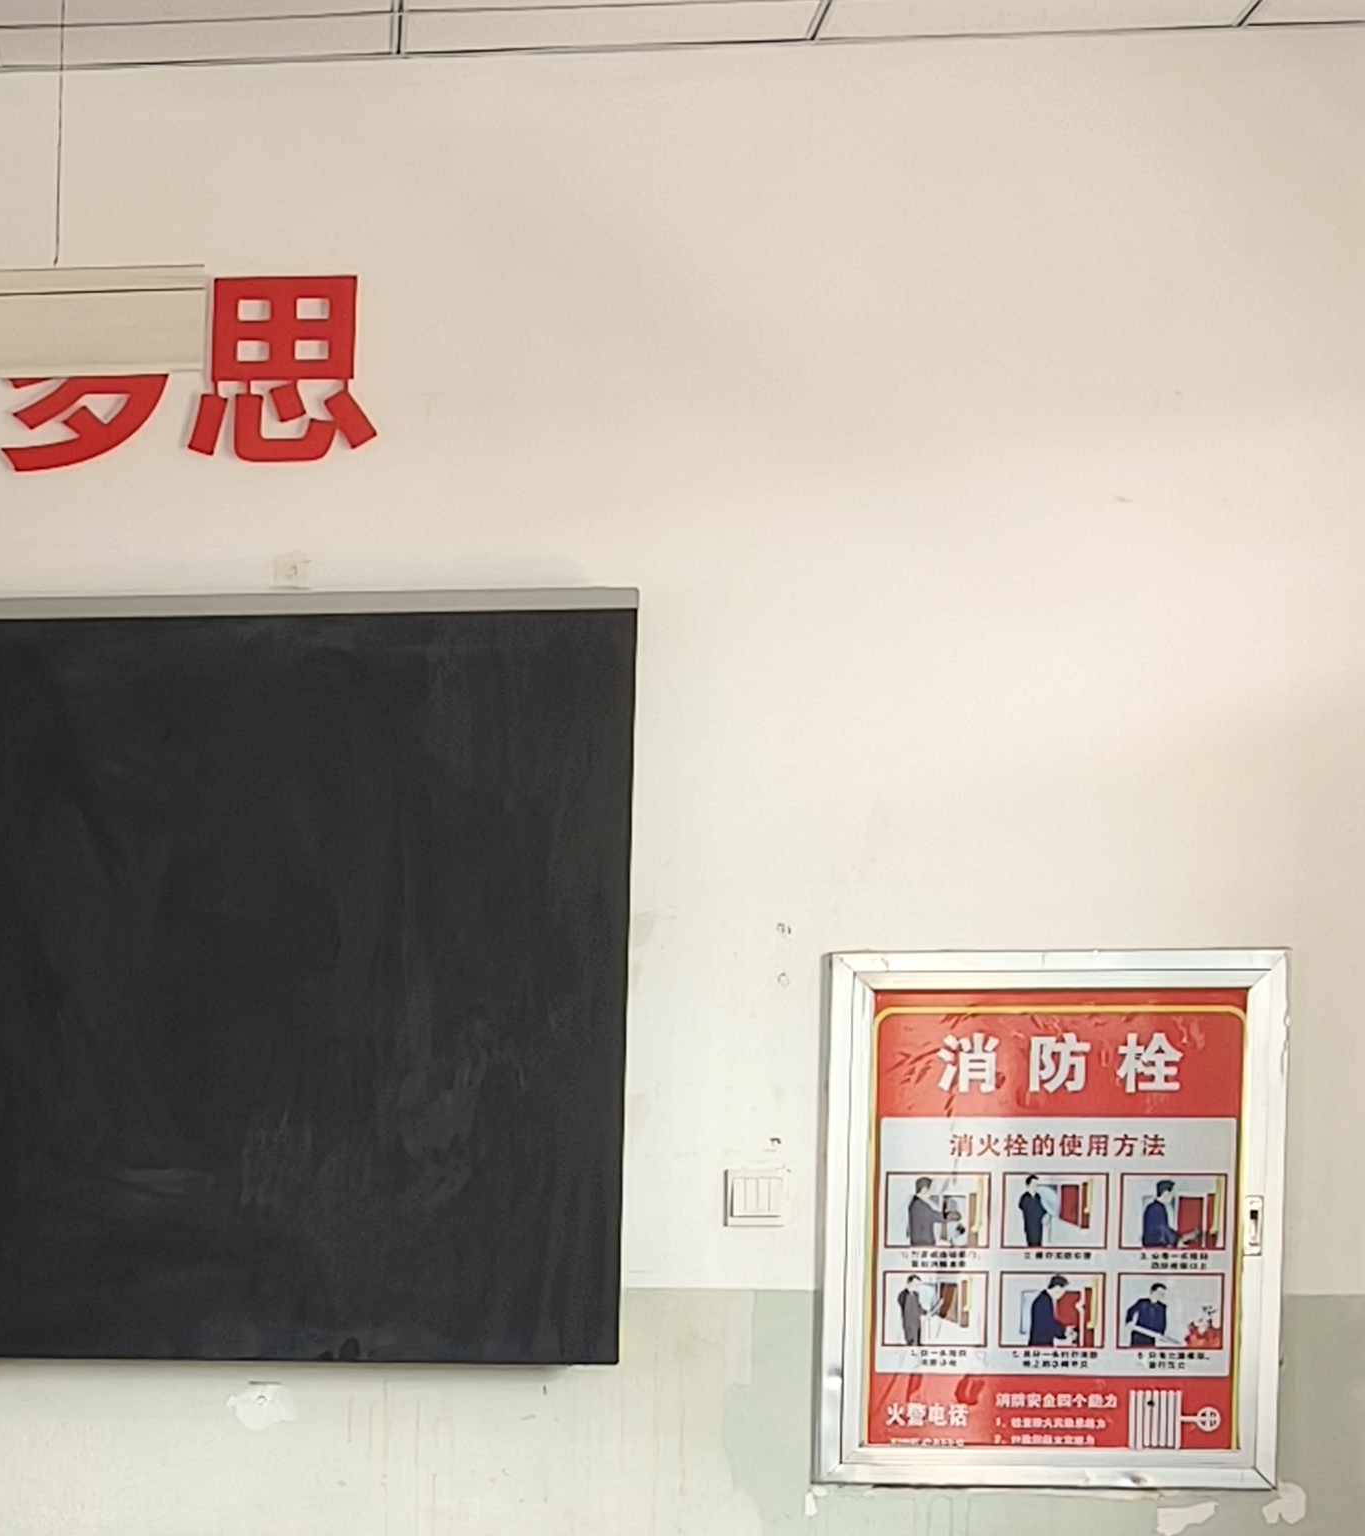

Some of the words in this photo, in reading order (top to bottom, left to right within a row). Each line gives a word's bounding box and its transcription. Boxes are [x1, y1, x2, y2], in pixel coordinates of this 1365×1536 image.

[937, 1032, 1183, 1095] 消防栓
[949, 1134, 1167, 1158] 消火栓的使用方法
[885, 1403, 969, 1428] 火警电话
